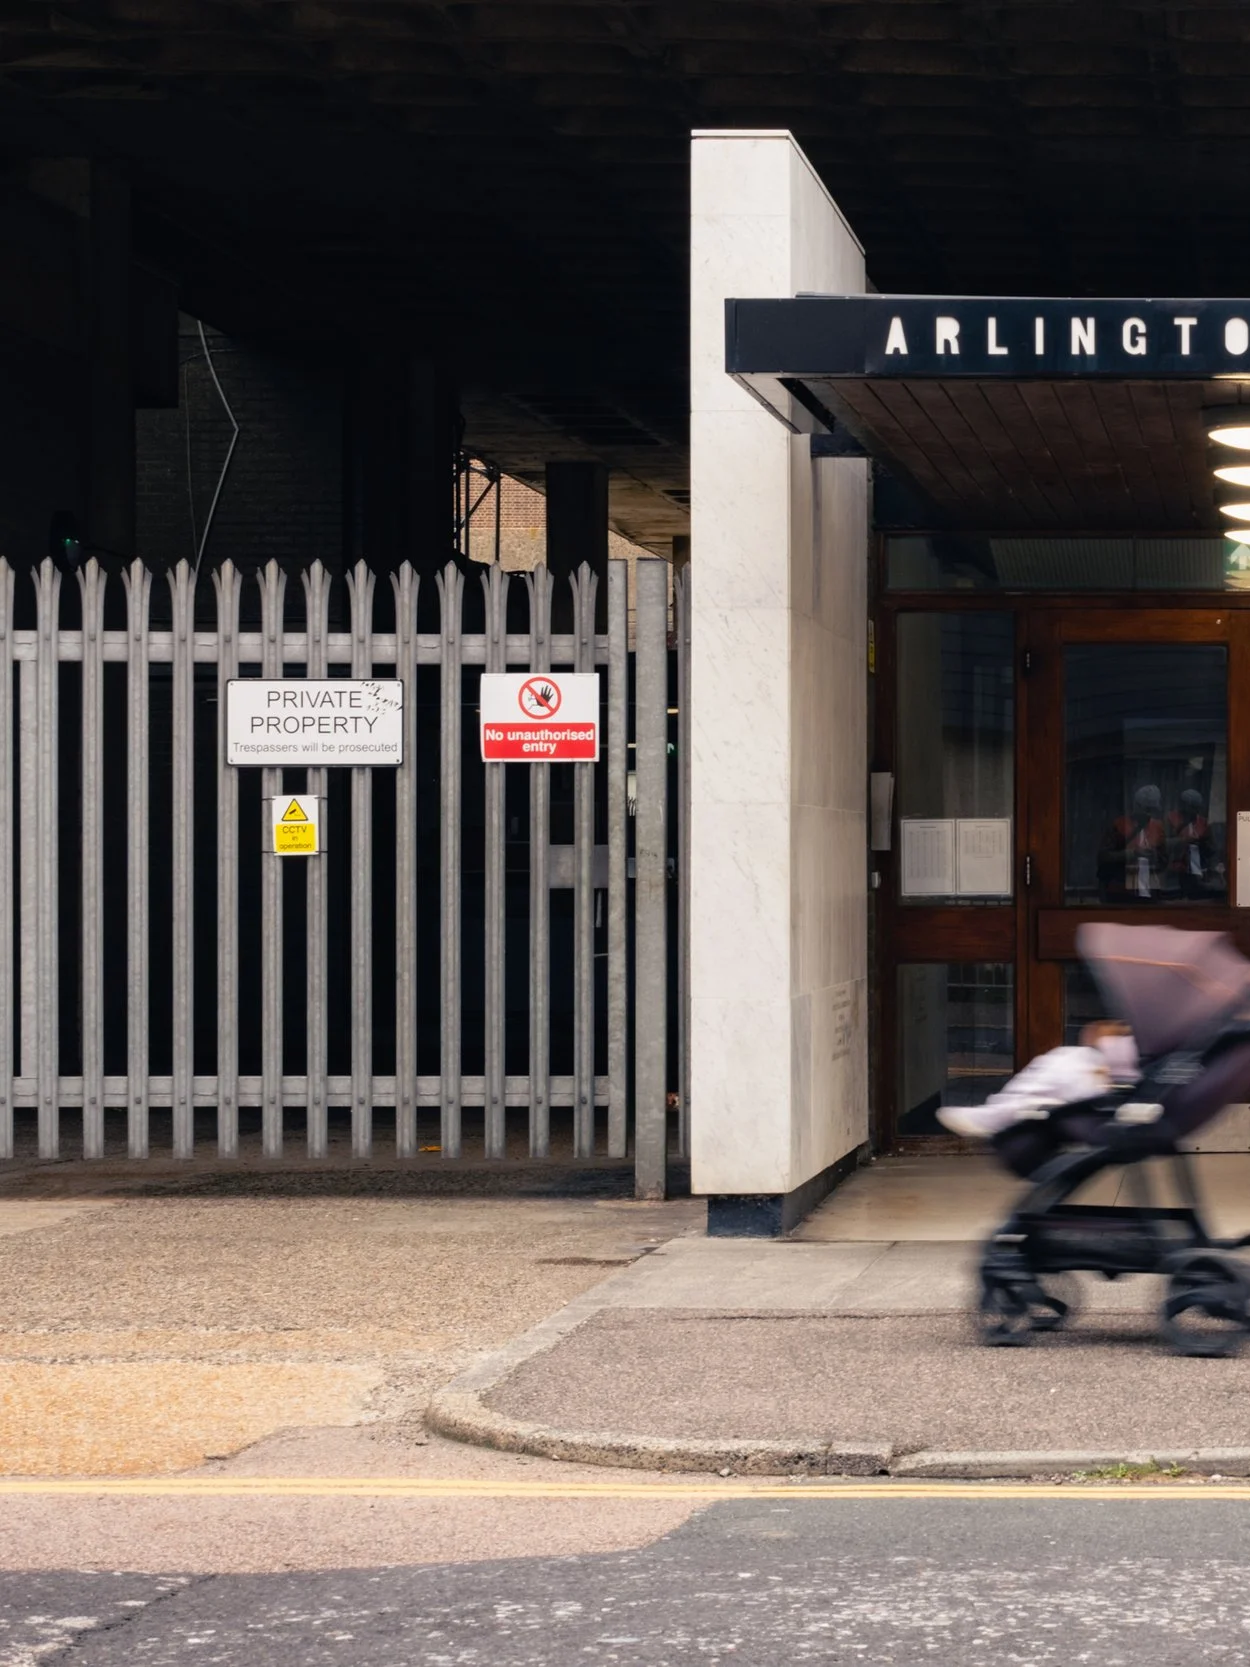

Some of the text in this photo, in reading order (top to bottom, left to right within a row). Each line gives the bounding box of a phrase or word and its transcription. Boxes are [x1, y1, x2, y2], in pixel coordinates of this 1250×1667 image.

[267, 690, 363, 708] PRIVATE
[250, 716, 378, 734] PROPERTY
[485, 728, 594, 741] No unauthorised
[233, 742, 398, 754] Trespassers will be prosecuted
[522, 740, 557, 755] entry
[282, 825, 307, 834] CCTV
